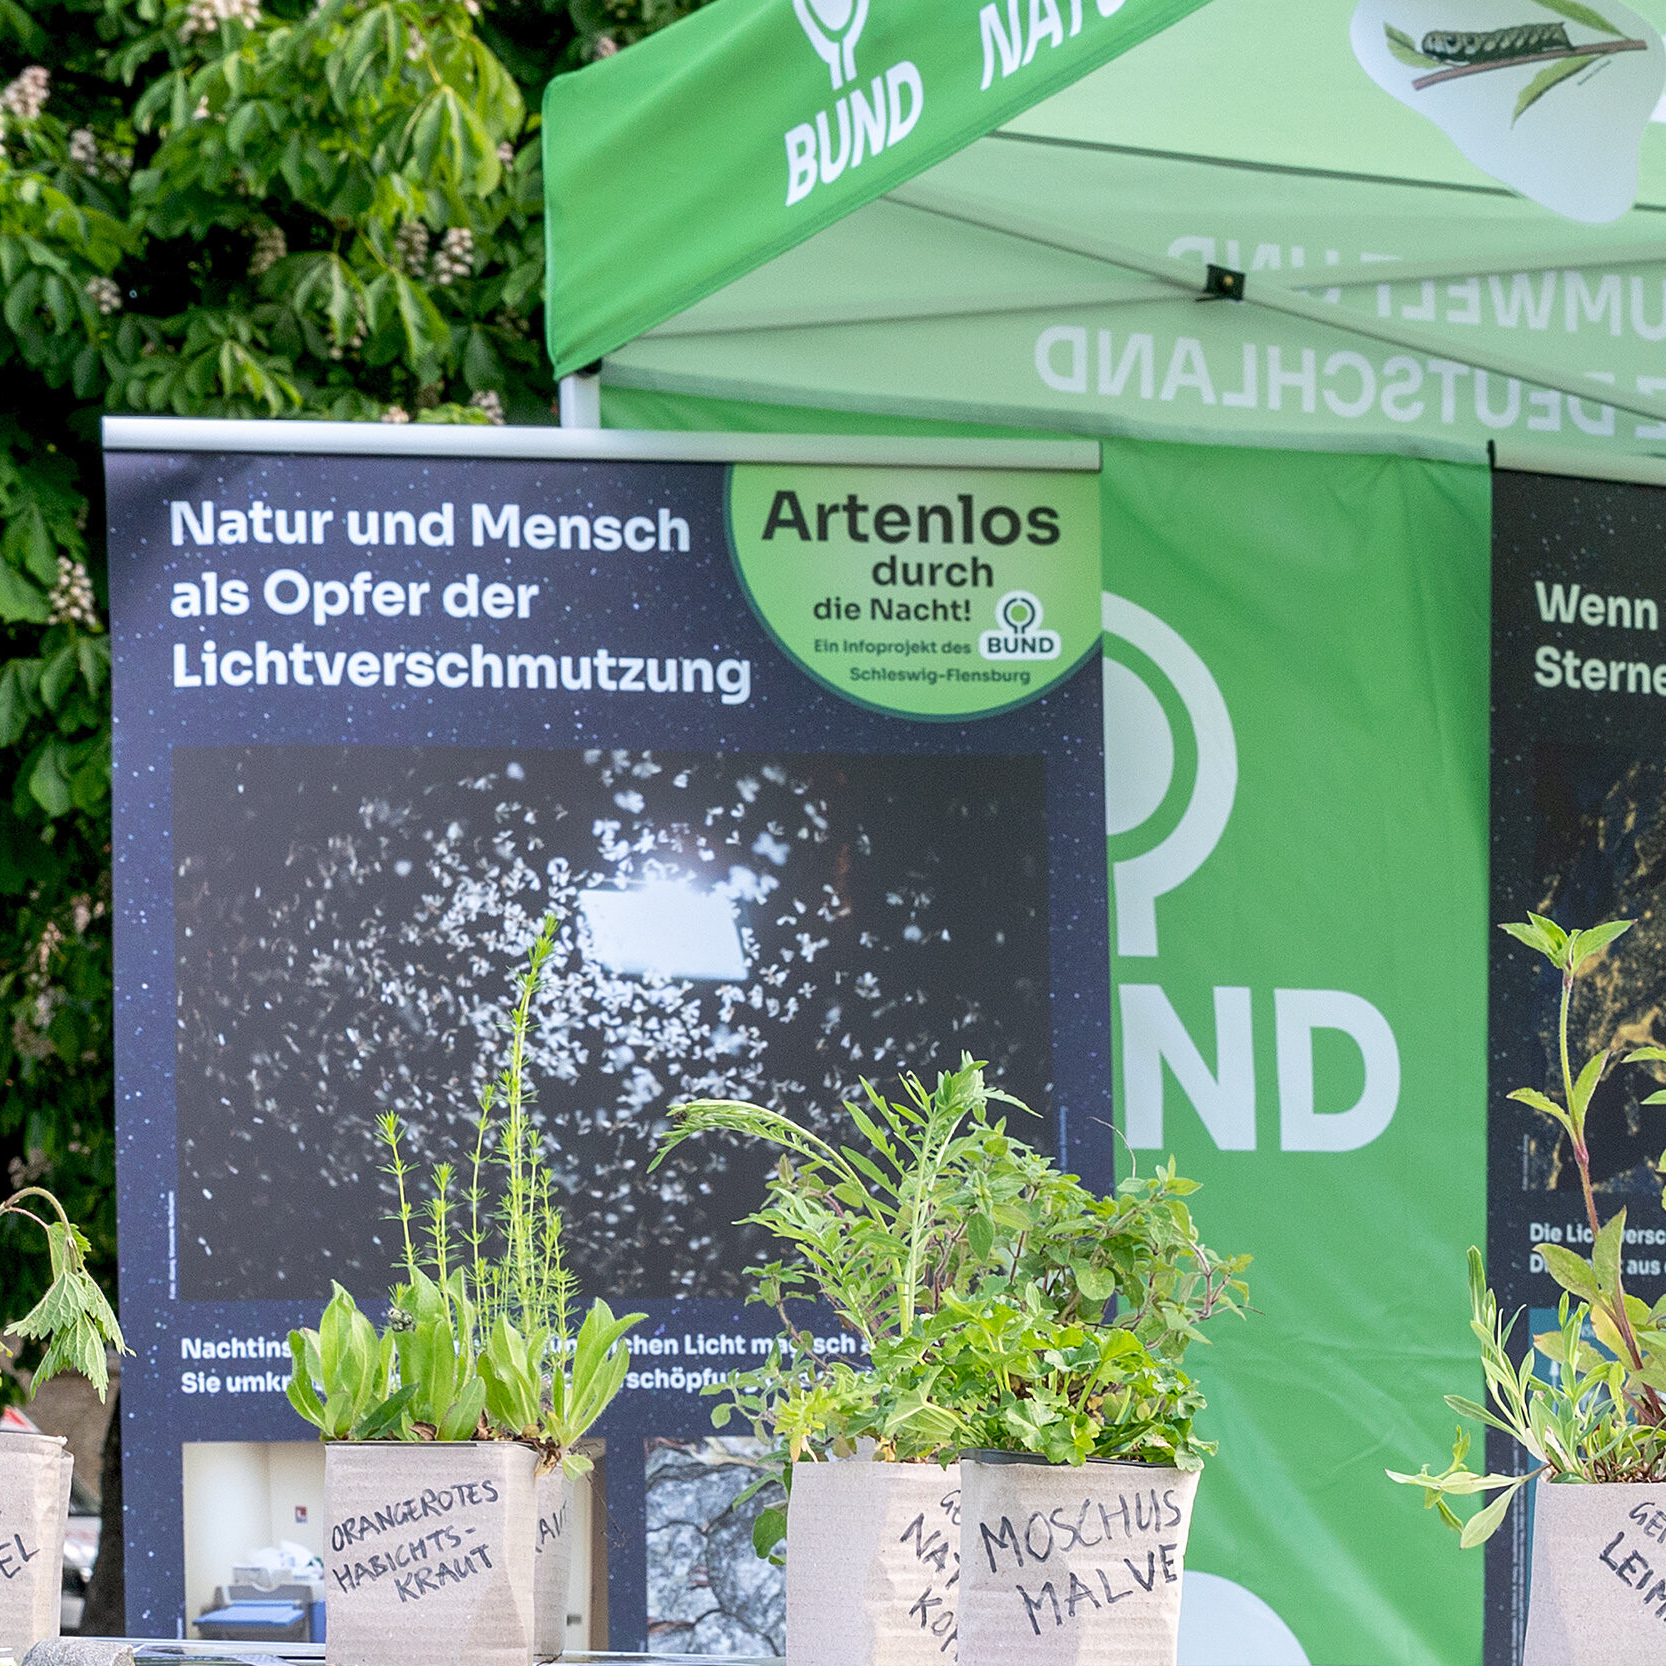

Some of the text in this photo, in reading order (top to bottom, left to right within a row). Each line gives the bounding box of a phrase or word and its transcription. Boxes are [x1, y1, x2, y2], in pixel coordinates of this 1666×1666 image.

[784, 60, 924, 207] BUND
[170, 500, 691, 554] Natur und Mensch
[762, 490, 1062, 549] Artenlos
[170, 570, 540, 626] als Opfer der
[871, 555, 995, 590] durch
[813, 597, 971, 622] die Nacht!
[1535, 582, 1659, 632] Wenn
[814, 639, 971, 657] Ein Infoprojekt des
[987, 637, 1055, 654] BUND
[171, 641, 752, 706] Lichtverschmutzung
[850, 667, 1031, 685] Schleswig-Flensburg
[1530, 1222, 1562, 1243] Die
[1626, 1259, 1661, 1276] aus
[685, 1333, 746, 1356] Licht
[182, 1371, 221, 1394] Sie
[332, 1480, 499, 1552] ORANGEROTES
[980, 1489, 1182, 1573] MOSCHUS
[333, 1525, 476, 1593] HABICHTS-
[394, 1544, 493, 1602] KRAUT
[1016, 1543, 1178, 1636] MALVE
